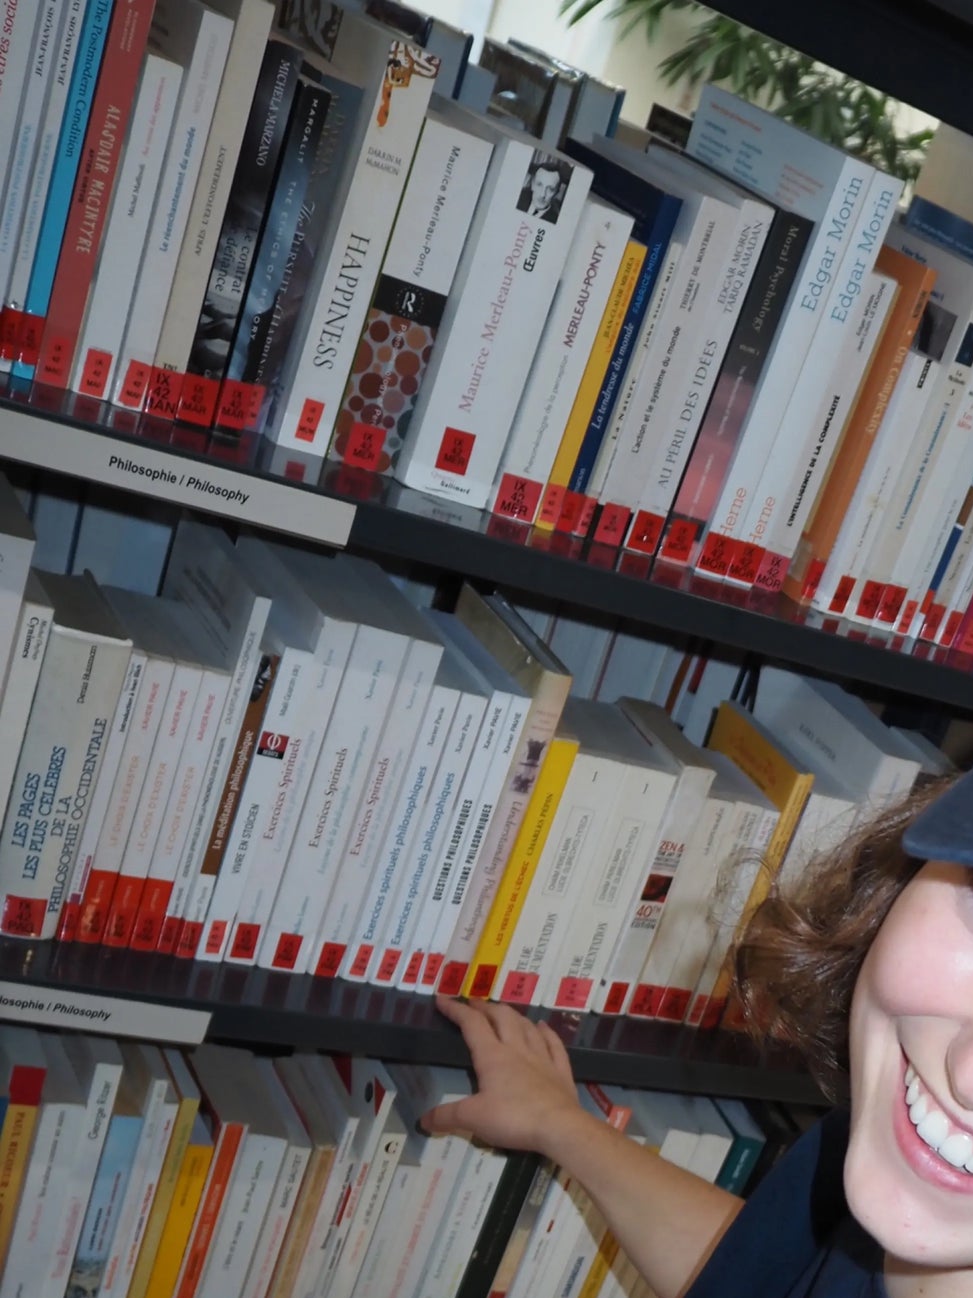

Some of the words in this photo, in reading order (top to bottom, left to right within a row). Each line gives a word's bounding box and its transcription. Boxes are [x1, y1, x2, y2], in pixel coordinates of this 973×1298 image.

[79, 24, 106, 97] Postmodern
[267, 59, 291, 111] MICHELA
[65, 100, 87, 158] Condition
[92, 103, 121, 173] ALASDAIR
[181, 126, 197, 156] monde
[253, 112, 278, 166] MARZANO
[295, 98, 318, 164] MARGALIT
[179, 157, 189, 170] du
[437, 145, 462, 193] Maurice
[159, 171, 188, 240] réenchantement
[283, 179, 296, 206] THE
[75, 178, 105, 254] MACINTYRE
[269, 210, 288, 259] ETHICS
[159, 241, 169, 252] Le
[408, 193, 448, 278] Merleau-Ponty
[521, 226, 548, 273] Œuvres
[694, 219, 717, 264] MONTBRIAL
[775, 223, 802, 264] Moral
[800, 247, 836, 312] Edgar
[827, 176, 864, 243] Morin
[263, 264, 274, 281] OF
[690, 263, 701, 276] DE
[716, 268, 737, 305] EDGAR
[729, 223, 752, 265] MORIN
[723, 278, 744, 314] TARIQ
[735, 219, 764, 278] RAMADAN
[831, 260, 868, 325] Edgar
[857, 189, 894, 256] Morin
[559, 240, 610, 348] MERLEAU-PONTY
[630, 271, 652, 314] FABRICE
[645, 240, 663, 271] MIDAL
[678, 277, 697, 310] THIERRY
[307, 231, 374, 372] HAPPINESS
[455, 344, 494, 414] Maurice
[476, 219, 537, 343] Merleau-Ponty
[747, 263, 789, 335] Psychology
[615, 320, 636, 356] monde
[665, 324, 682, 352] monde
[92, 369, 101, 377] 42
[610, 356, 624, 372] du
[661, 351, 672, 365] du
[689, 337, 718, 387] IDÉES
[152, 385, 170, 400] 42
[155, 372, 172, 386] IX
[594, 371, 619, 414] tendresse
[647, 365, 670, 404] système
[220, 405, 244, 419] MAR
[589, 413, 604, 429] La
[642, 413, 651, 424] et
[645, 403, 654, 412] le
[678, 390, 700, 422] DES
[630, 424, 648, 454] L'action
[661, 425, 687, 465] PÉRIL
[812, 443, 823, 456] LA
[107, 455, 178, 486] Philosophie
[179, 475, 185, 485] /
[184, 476, 251, 506] Philosophy
[654, 464, 674, 489] AU
[808, 455, 819, 469] DE
[438, 479, 470, 495] Gallimard
[509, 491, 525, 505] 42
[513, 480, 527, 493] IX
[783, 468, 815, 527] L'INTELLIGENCE
[499, 500, 528, 516] MER
[699, 554, 726, 571] MOR
[710, 547, 724, 559] 42
[728, 563, 755, 579] MOR
[739, 555, 752, 568] 42
[765, 565, 780, 579] 42
[770, 555, 782, 568] IX
[755, 573, 781, 590] MOR
[19, 615, 40, 659] Cynismes
[80, 644, 99, 681] Huisman
[75, 681, 90, 705] Denis
[482, 726, 496, 750] Xavier
[489, 705, 503, 727] PAVIE
[501, 731, 515, 755] Xavier
[509, 710, 522, 732] PAVIE
[227, 728, 254, 791] philosophique
[15, 771, 42, 819] PAGES
[56, 793, 72, 815] LA
[262, 788, 287, 841] Exercices
[277, 736, 302, 789] Spirituels
[306, 796, 334, 849] Exercices
[322, 745, 349, 797] Spirituels
[348, 806, 375, 857] Exercices
[364, 755, 391, 807] Spirituels
[10, 819, 31, 847] LES
[44, 821, 83, 914] PHILOSOPHIE
[66, 716, 110, 825] OCCIDENTALE
[50, 816, 66, 838] DE
[214, 791, 236, 838] méditation
[241, 802, 260, 838] STOÏCIEN
[27, 818, 49, 852] PLUS
[211, 839, 222, 850] La
[238, 838, 249, 851] EN
[361, 893, 386, 941] Exercices
[376, 845, 402, 895] spirituels
[392, 763, 429, 846] philosophiques
[432, 860, 453, 901] QUESTIONS
[445, 797, 474, 861] PHILOSOPHIQUES
[451, 864, 473, 906] QUESTIONS
[464, 801, 494, 865] PHILOSOPHIQUES
[482, 797, 522, 877] Understanding
[20, 852, 41, 881] LES
[231, 851, 246, 875] VIVRE
[389, 898, 414, 947] Exercices
[404, 851, 430, 900] spirituels
[420, 770, 457, 852] philosophiques
[459, 874, 495, 943] Philanthropy
[46, 1003, 51, 1011] /
[53, 1003, 111, 1021] Philosophy
[89, 1101, 106, 1140] George
[240, 1181, 256, 1213] Jean-Paul
[279, 1184, 292, 1208] MARC
[286, 1153, 302, 1183] SAUTET
